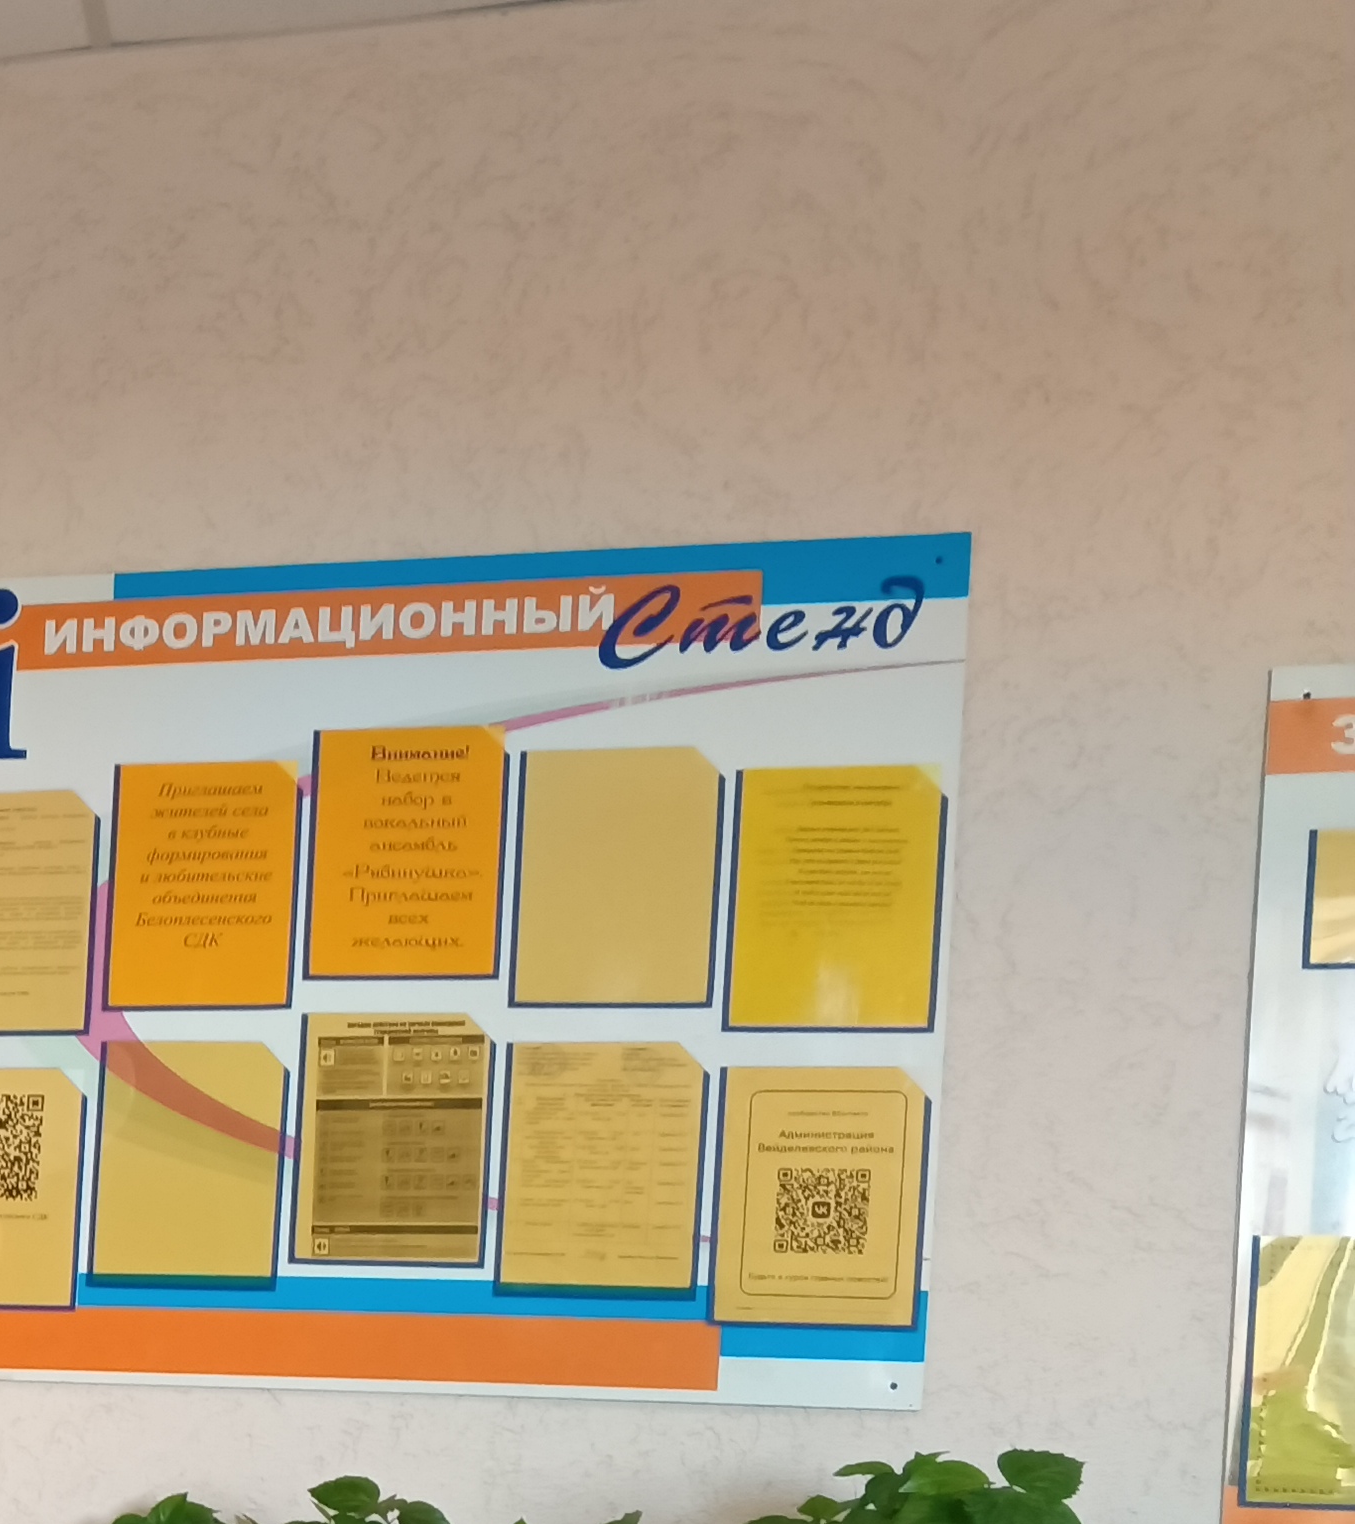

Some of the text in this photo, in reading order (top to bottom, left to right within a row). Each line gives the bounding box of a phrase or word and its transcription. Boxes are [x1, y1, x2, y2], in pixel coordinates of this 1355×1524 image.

[44, 575, 925, 670] ИНФОРМАЦИОННЫЙ Стенд
[369, 744, 471, 762] Внимание!
[157, 782, 264, 800] Приглашаем
[381, 790, 452, 810] набор в
[150, 802, 269, 819] жителей села
[363, 814, 467, 830] вокальный
[167, 825, 250, 843] в клубные
[369, 836, 458, 852] ансамбль
[146, 847, 269, 866] формирования
[139, 868, 273, 885] и любительские
[349, 886, 474, 906] Приглашаем
[134, 911, 273, 928] Белоплесенского
[388, 913, 429, 925] всех
[183, 931, 224, 949] СДК
[778, 1129, 875, 1142] Администрация
[850, 1144, 895, 1156] района
